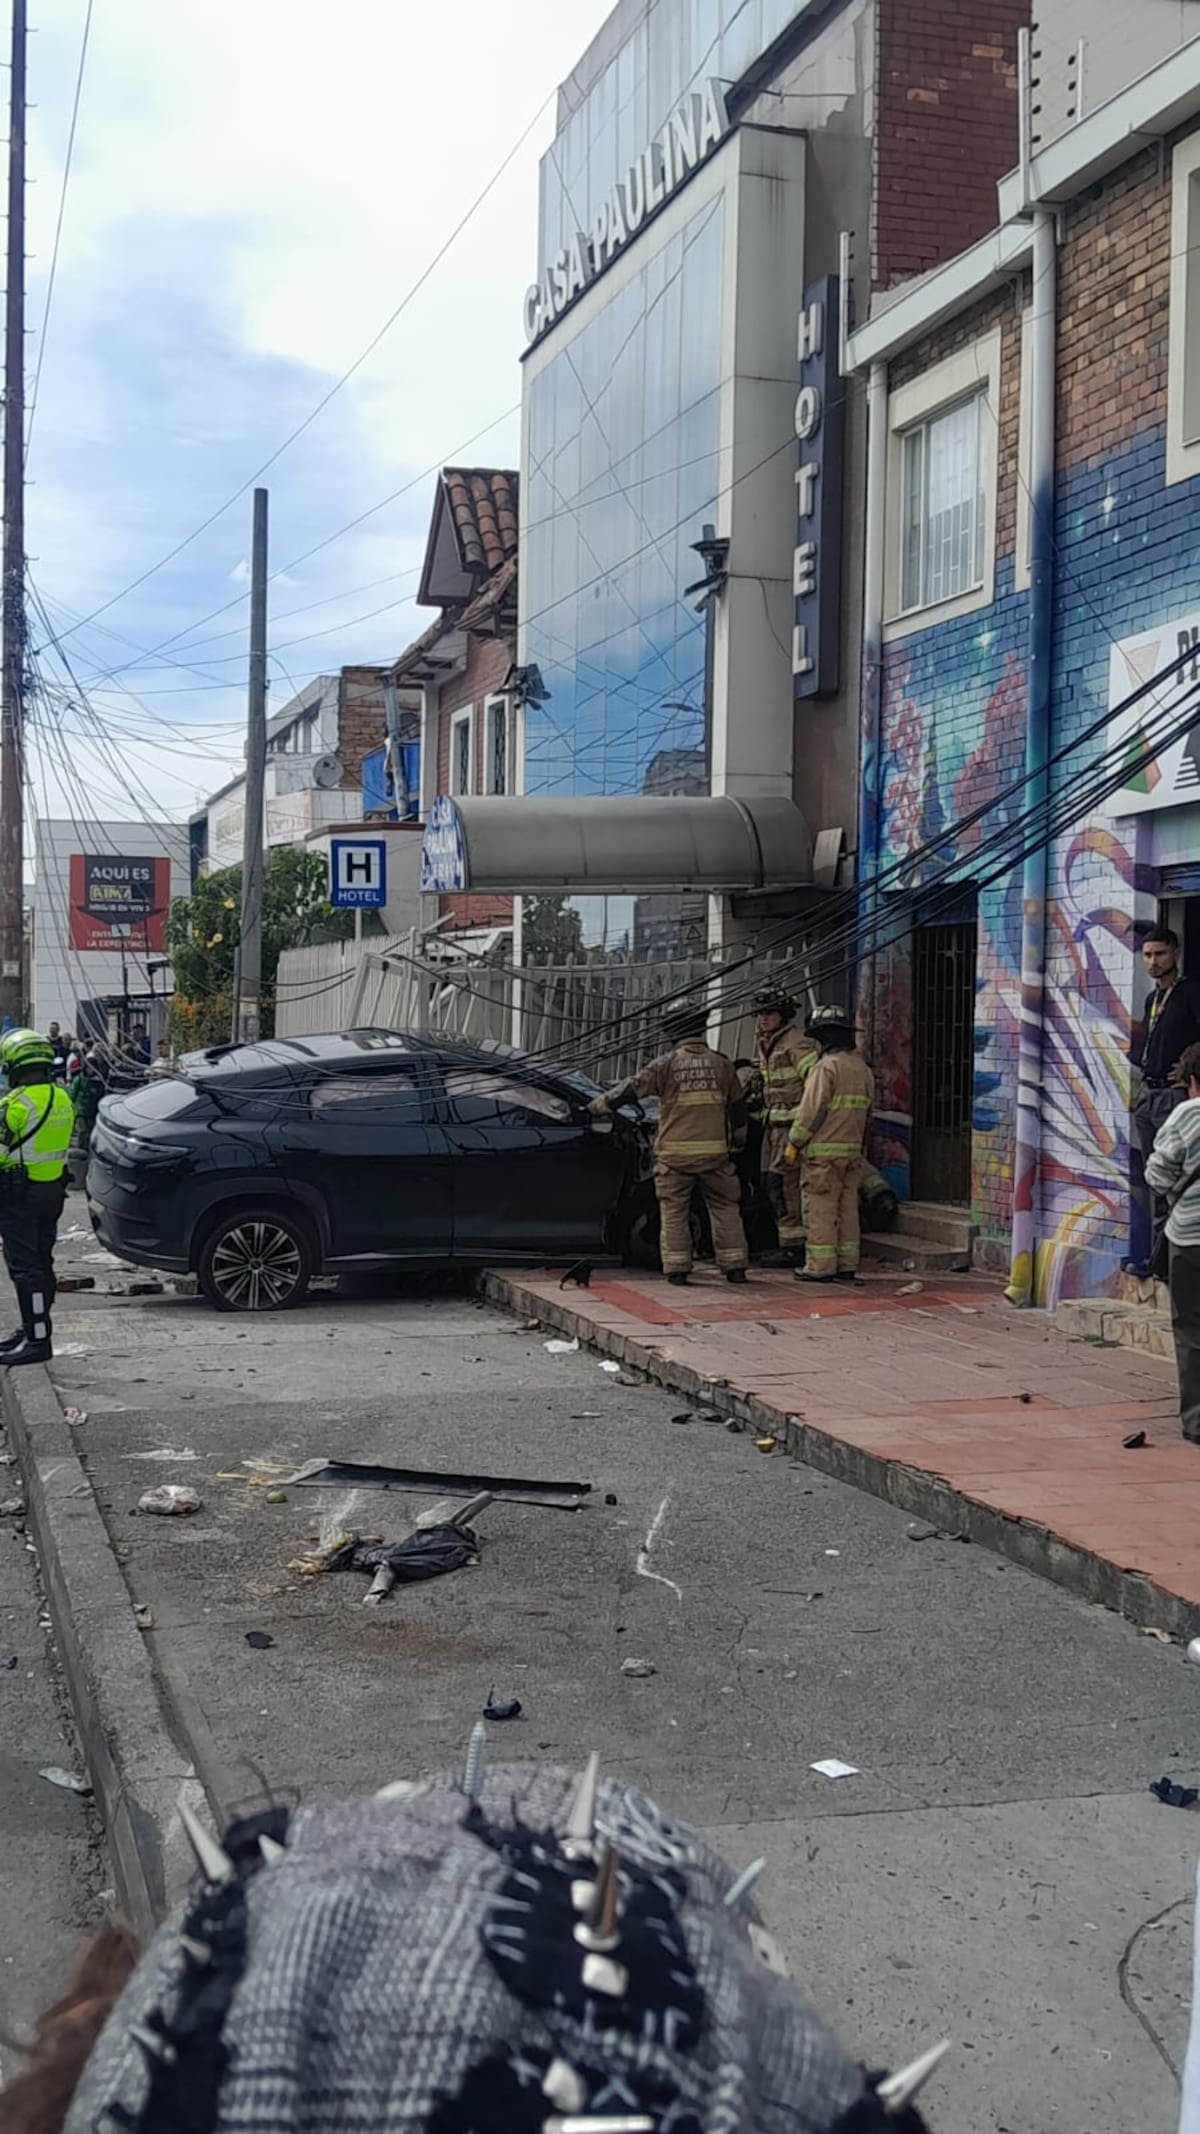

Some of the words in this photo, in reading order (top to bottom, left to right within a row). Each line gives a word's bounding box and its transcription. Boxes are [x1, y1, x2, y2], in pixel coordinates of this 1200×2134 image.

[524, 232, 590, 343] CASA
[594, 77, 730, 271] PAULINA
[792, 302, 823, 675] HOTEL
[132, 867, 150, 880] ES
[347, 853, 371, 883] H
[338, 890, 380, 902] HOTEL
